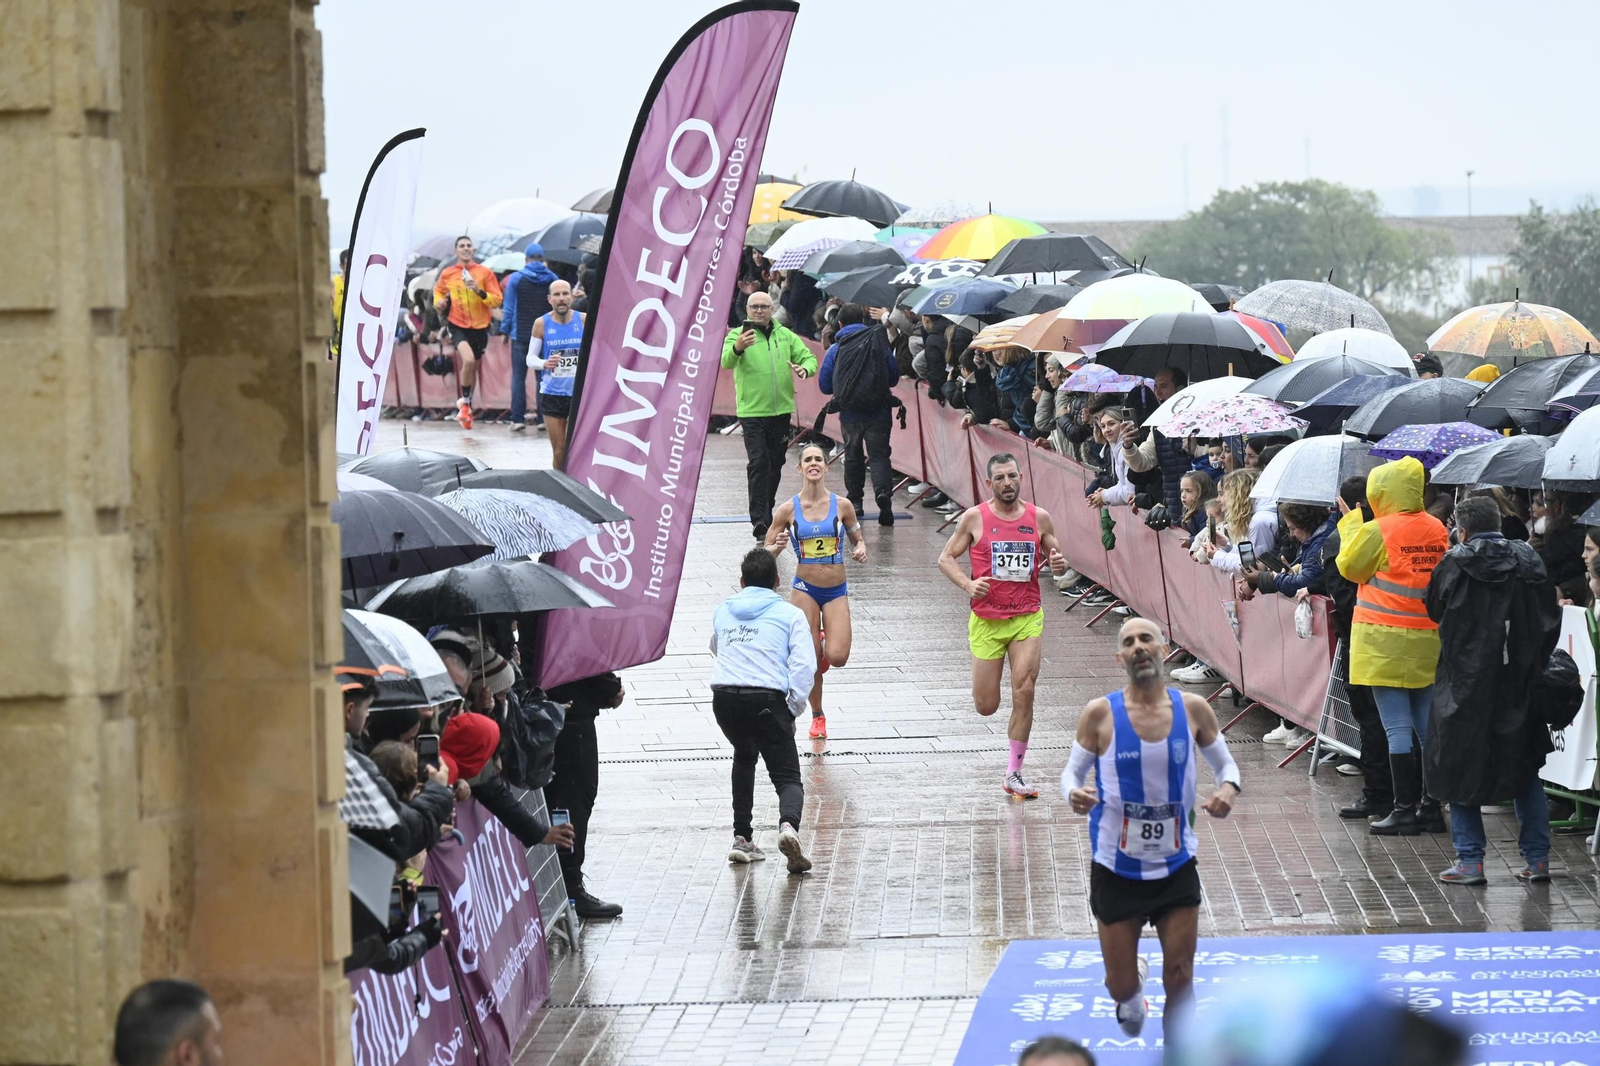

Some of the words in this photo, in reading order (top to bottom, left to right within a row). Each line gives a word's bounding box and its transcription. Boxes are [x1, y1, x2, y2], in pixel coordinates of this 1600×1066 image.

[714, 137, 748, 231] Córdoba
[688, 238, 724, 343] Deportes
[592, 118, 720, 481] IMDECO
[546, 338, 582, 347] TROTASIERR
[556, 357, 578, 367] 924
[682, 348, 702, 379] de
[660, 381, 695, 499] Municipal
[644, 504, 673, 599] Instituto
[815, 539, 825, 551] 2
[997, 554, 1030, 568] 3715
[1118, 750, 1140, 760] vive
[1141, 823, 1165, 840] 89
[1452, 989, 1586, 999] MEDIA
[1450, 1006, 1585, 1015] CÓRDOBA
